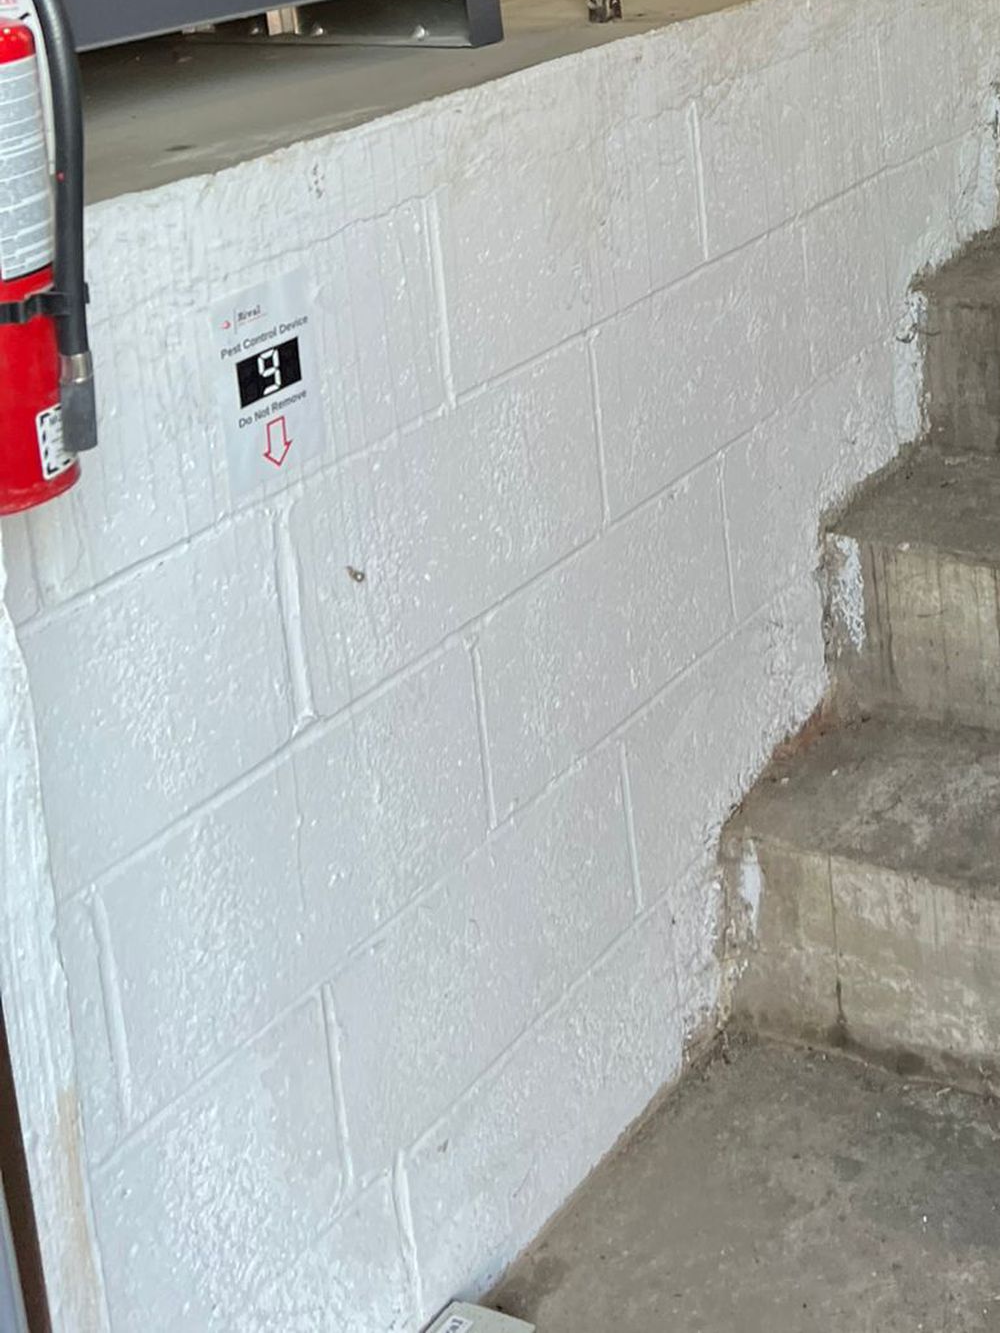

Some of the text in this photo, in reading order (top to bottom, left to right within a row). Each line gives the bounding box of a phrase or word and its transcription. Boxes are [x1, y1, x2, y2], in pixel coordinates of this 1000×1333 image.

[220, 344, 242, 359] Pest
[243, 327, 278, 349] Control
[279, 316, 308, 334] Device
[238, 390, 307, 428] Do Not Remove
